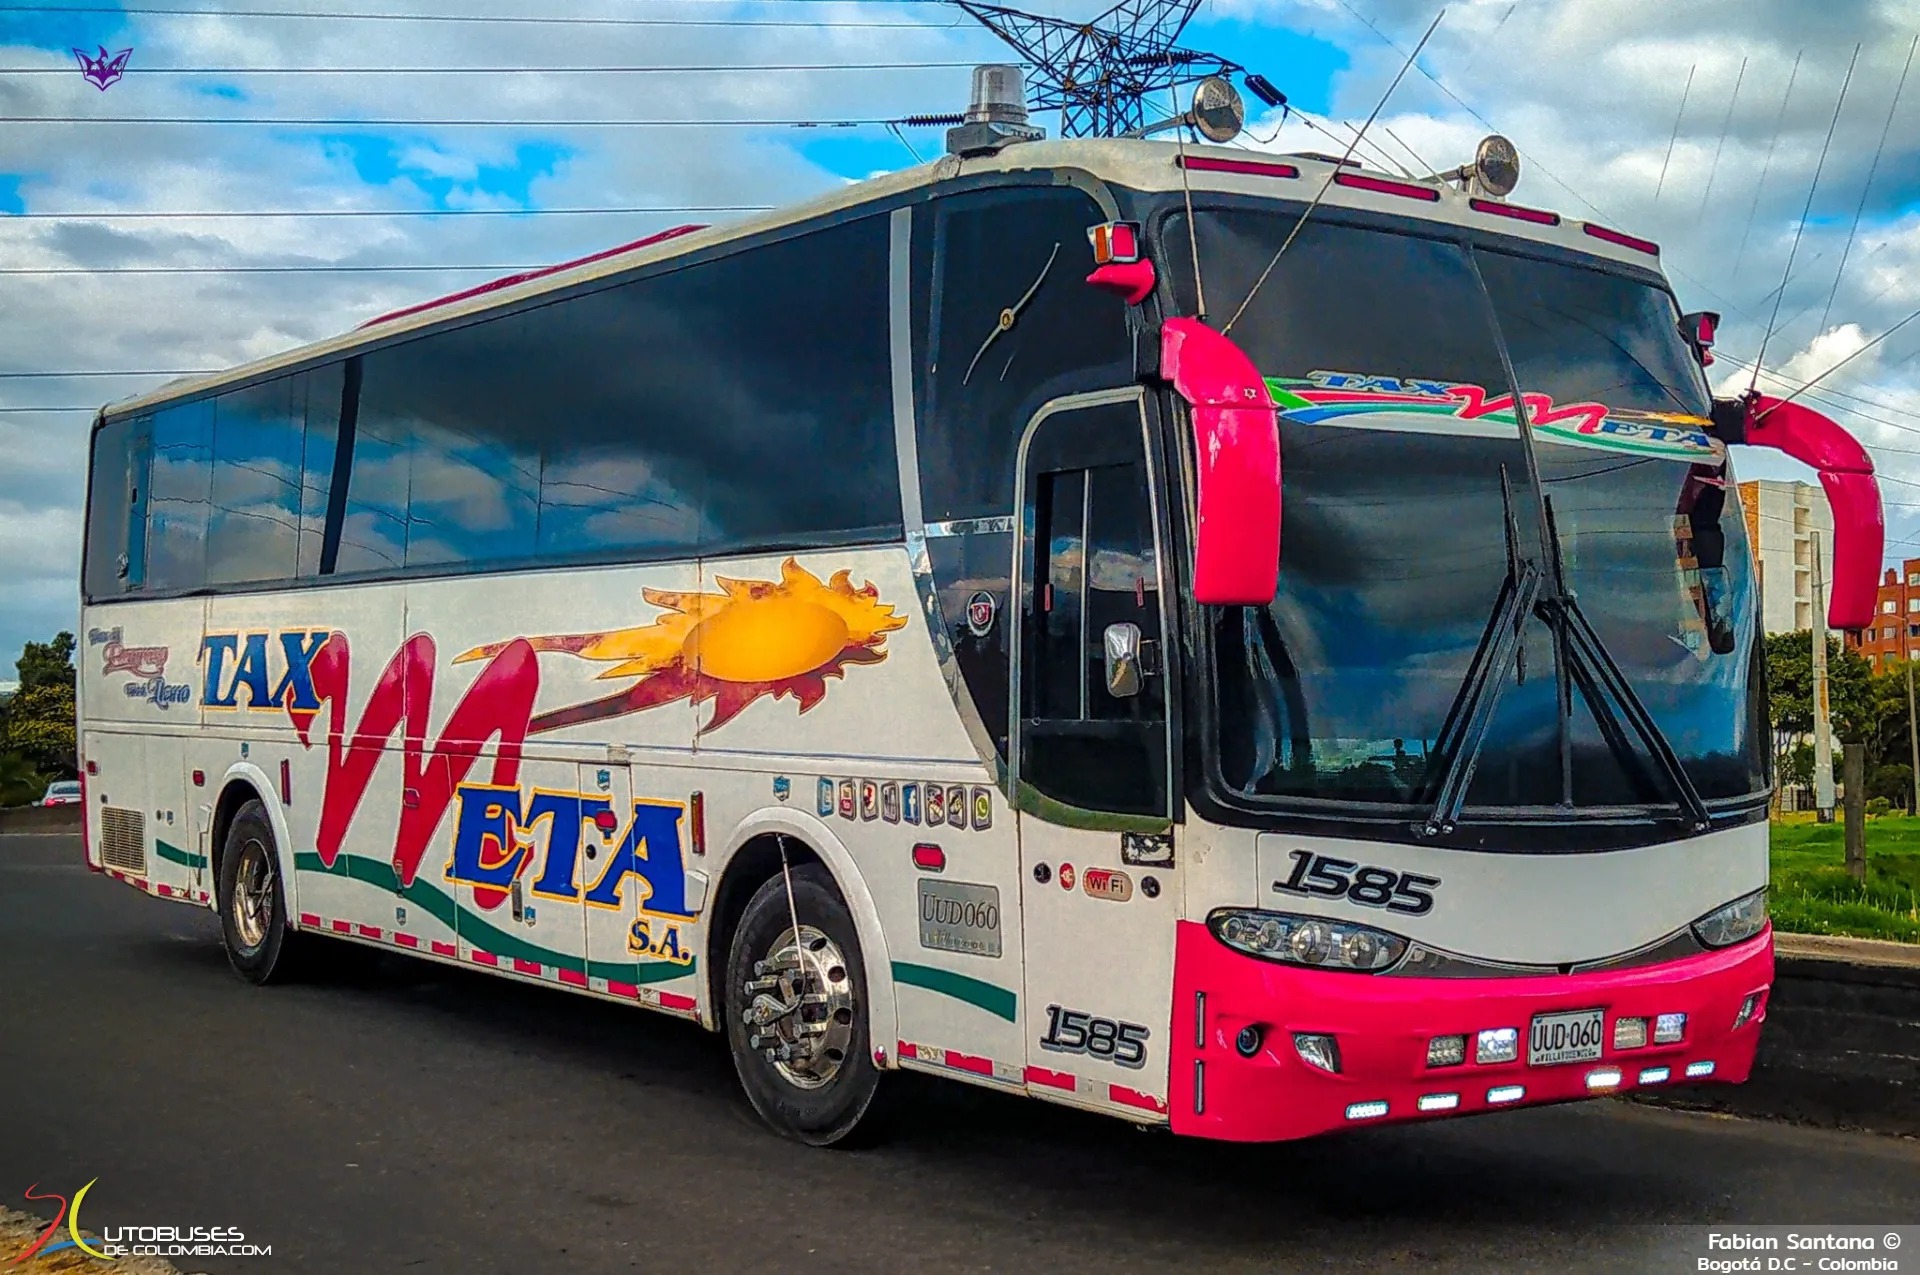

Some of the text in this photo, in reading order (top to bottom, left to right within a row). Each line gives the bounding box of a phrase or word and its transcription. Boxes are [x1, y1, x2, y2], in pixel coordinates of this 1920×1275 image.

[1306, 370, 1458, 396] TAX
[196, 626, 331, 715] TAX
[922, 890, 998, 930] UUD060
[1272, 849, 1442, 917] 1585
[627, 917, 691, 965] S.A.
[1040, 1003, 1151, 1069] 1585
